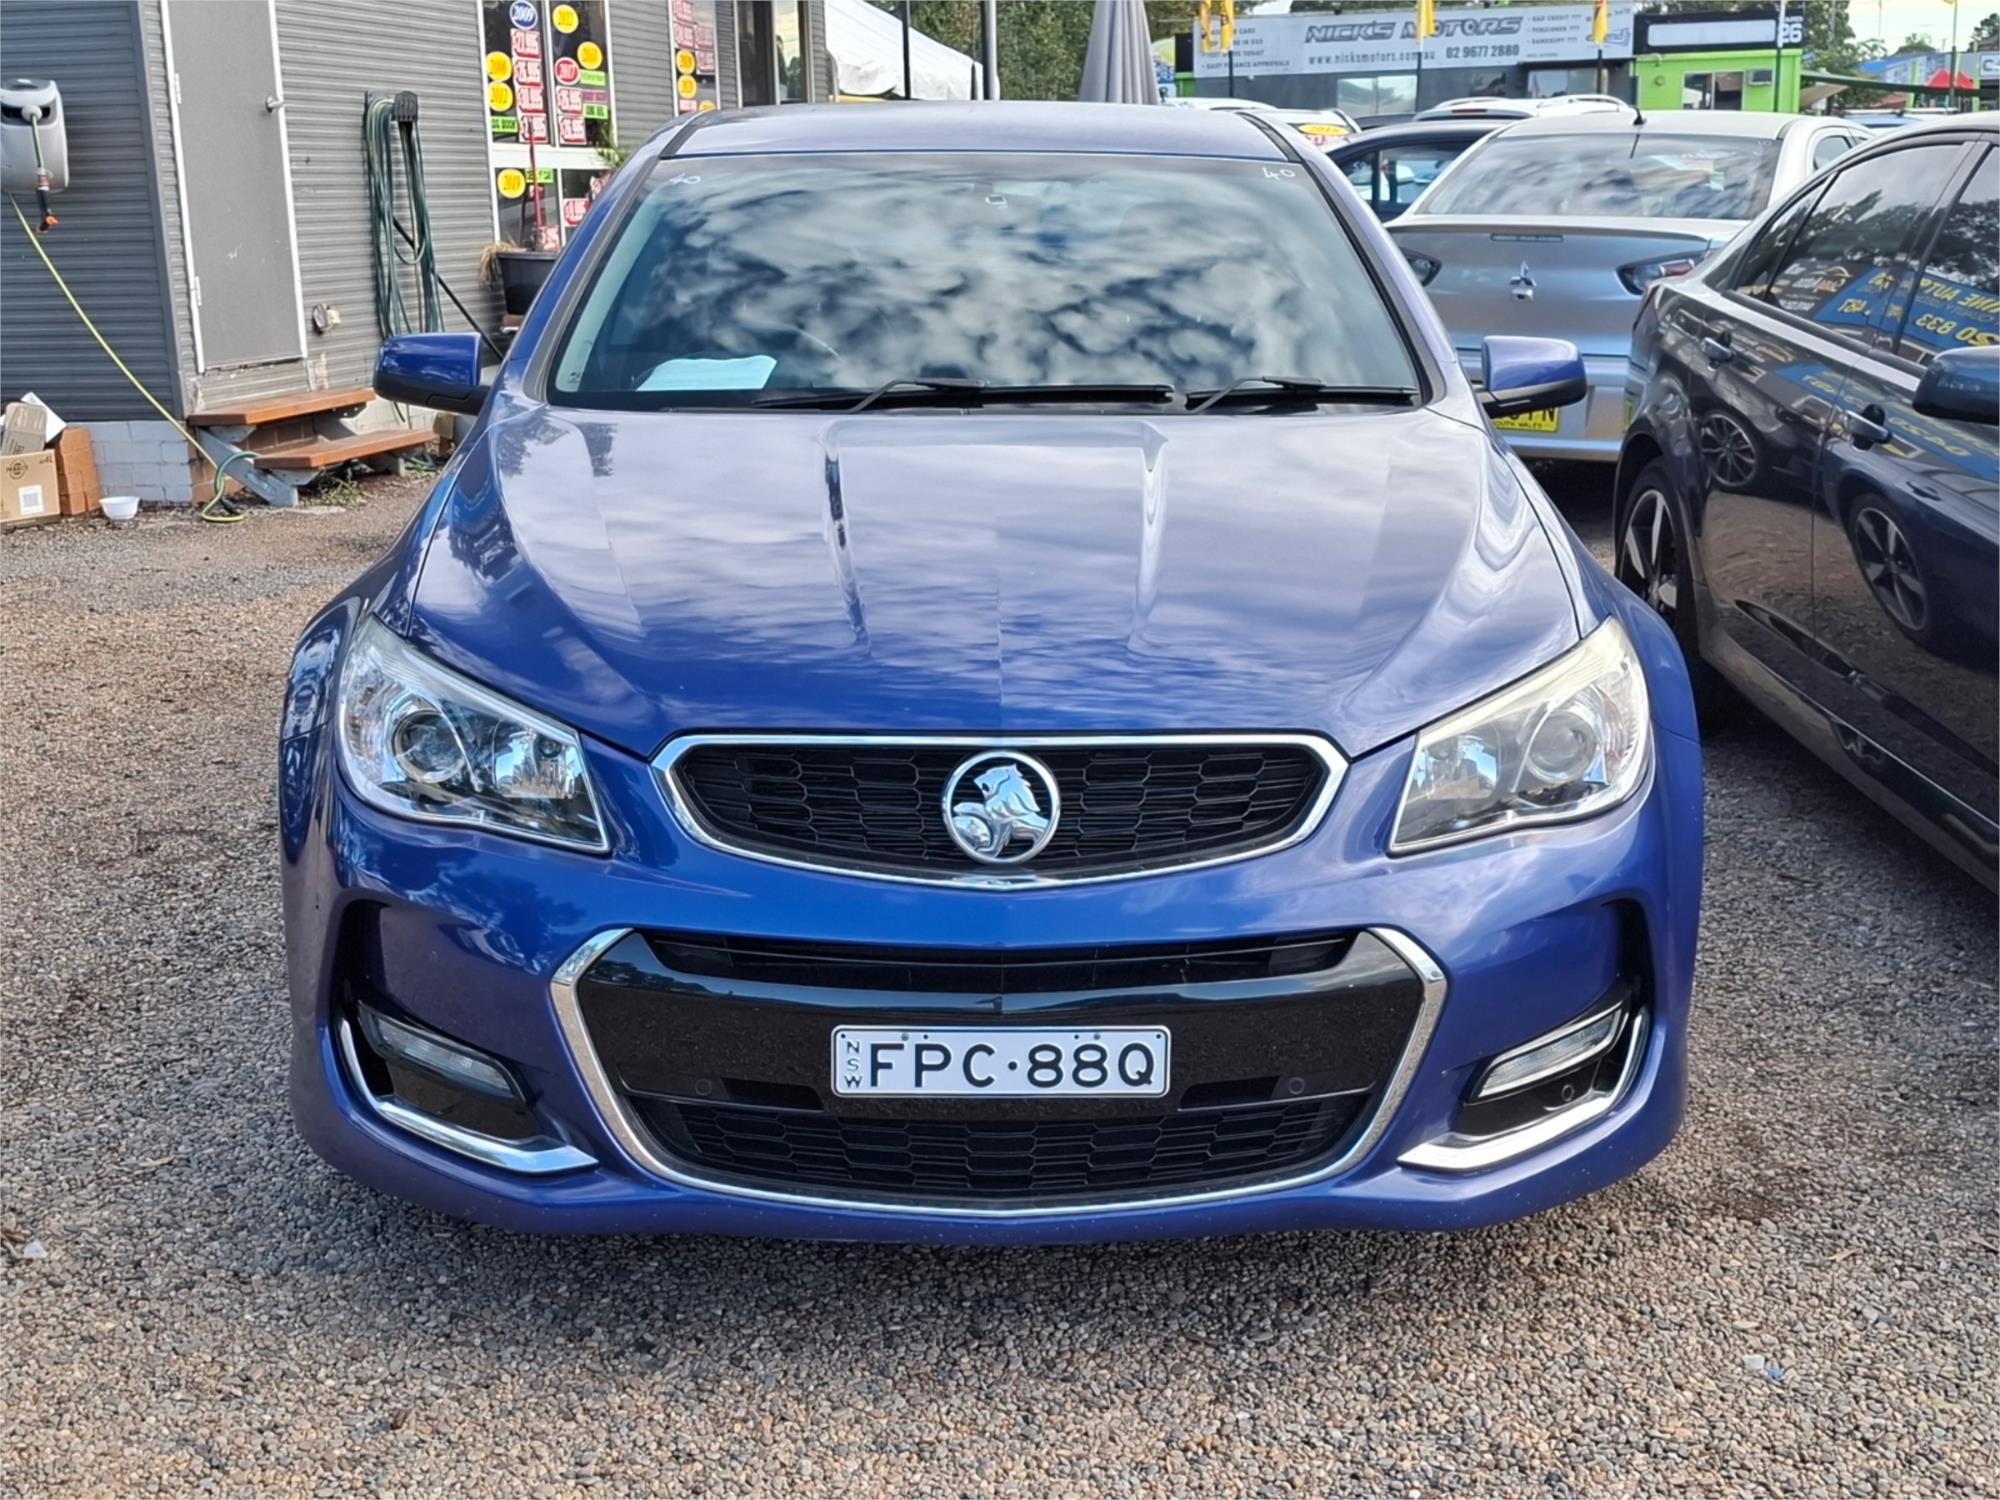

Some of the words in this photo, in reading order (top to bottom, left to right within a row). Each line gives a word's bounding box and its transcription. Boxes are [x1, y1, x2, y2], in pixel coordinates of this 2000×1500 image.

[1304, 21, 1397, 43] NICK'S
[1445, 46, 1460, 59] 02
[1462, 45, 1489, 58] 9677
